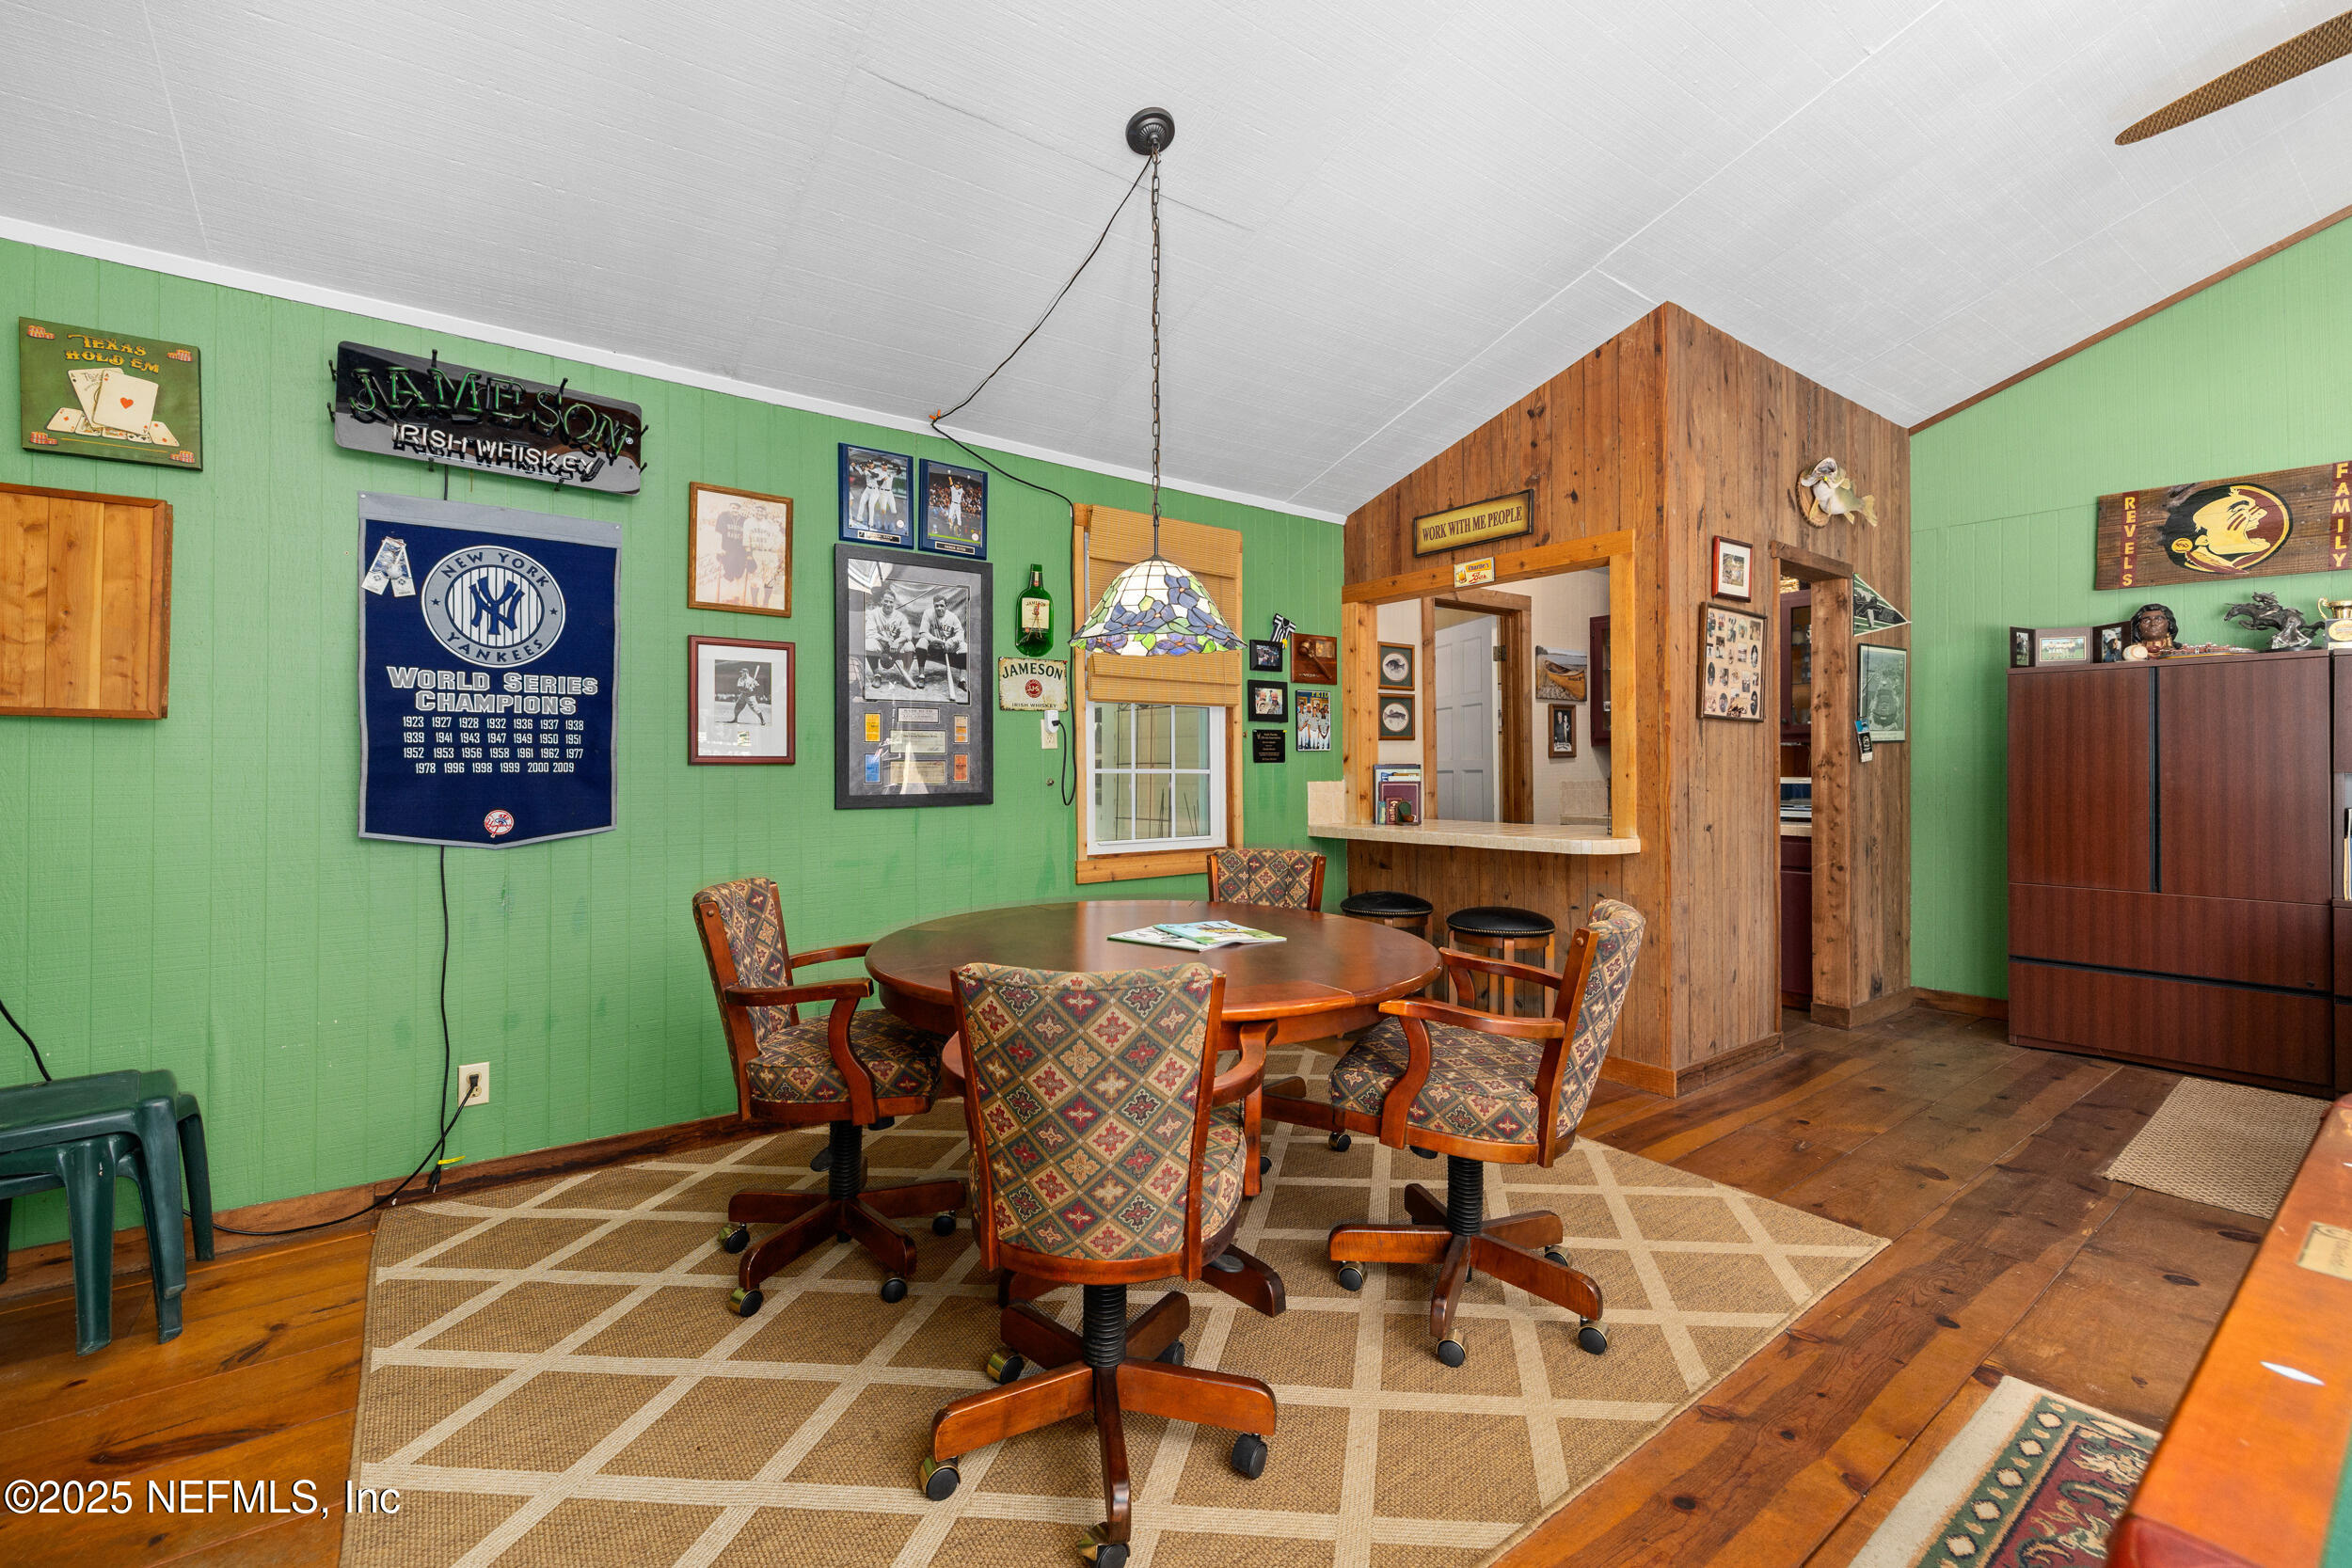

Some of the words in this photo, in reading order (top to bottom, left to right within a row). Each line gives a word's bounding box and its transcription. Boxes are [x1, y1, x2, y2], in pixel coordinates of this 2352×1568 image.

[65, 350, 125, 366] HOLD
[68, 334, 147, 356] TEXAS
[349, 366, 634, 457] JAMESON
[391, 423, 467, 453] IRISH
[476, 438, 596, 475] WHISKEY
[1422, 523, 1447, 543] WORK
[1447, 517, 1471, 536] WITH
[1472, 514, 1486, 531] ME
[1487, 505, 1522, 528] PEOPLE
[2331, 462, 2351, 568] FAMILY
[2122, 496, 2137, 587] REVELS
[440, 551, 484, 578] NEW
[498, 552, 549, 588] YORK
[447, 631, 544, 663] YANKEES
[386, 666, 490, 691] WORLD
[503, 672, 598, 695] SERIES
[1002, 662, 1063, 681] JAMESON
[415, 690, 577, 715] CHAMPIONS
[403, 717, 423, 727] 1923
[431, 717, 452, 727] 1927
[458, 718, 479, 728] 1928
[486, 719, 506, 728] 1932
[513, 719, 532, 729] 1936
[540, 720, 559, 729] 1937
[564, 721, 583, 730] 1938
[403, 732, 424, 742] 1939
[435, 732, 453, 742] 1941
[460, 733, 480, 743] 1943
[487, 733, 506, 743] 1947
[513, 734, 532, 743] 1949
[539, 734, 558, 744] 1950
[564, 735, 580, 744] 1951
[403, 747, 424, 758] 1952
[433, 748, 453, 758] 1953
[461, 748, 482, 758] 1956
[489, 748, 509, 758] 1958
[516, 748, 533, 758] 1961
[540, 748, 559, 758] 1962
[565, 748, 583, 758] 1977
[415, 763, 436, 773] 1978
[443, 763, 464, 773] 1996
[471, 763, 492, 772] 1998
[500, 763, 519, 772] 1999
[527, 763, 548, 772] 2000
[552, 763, 574, 772] 2009
